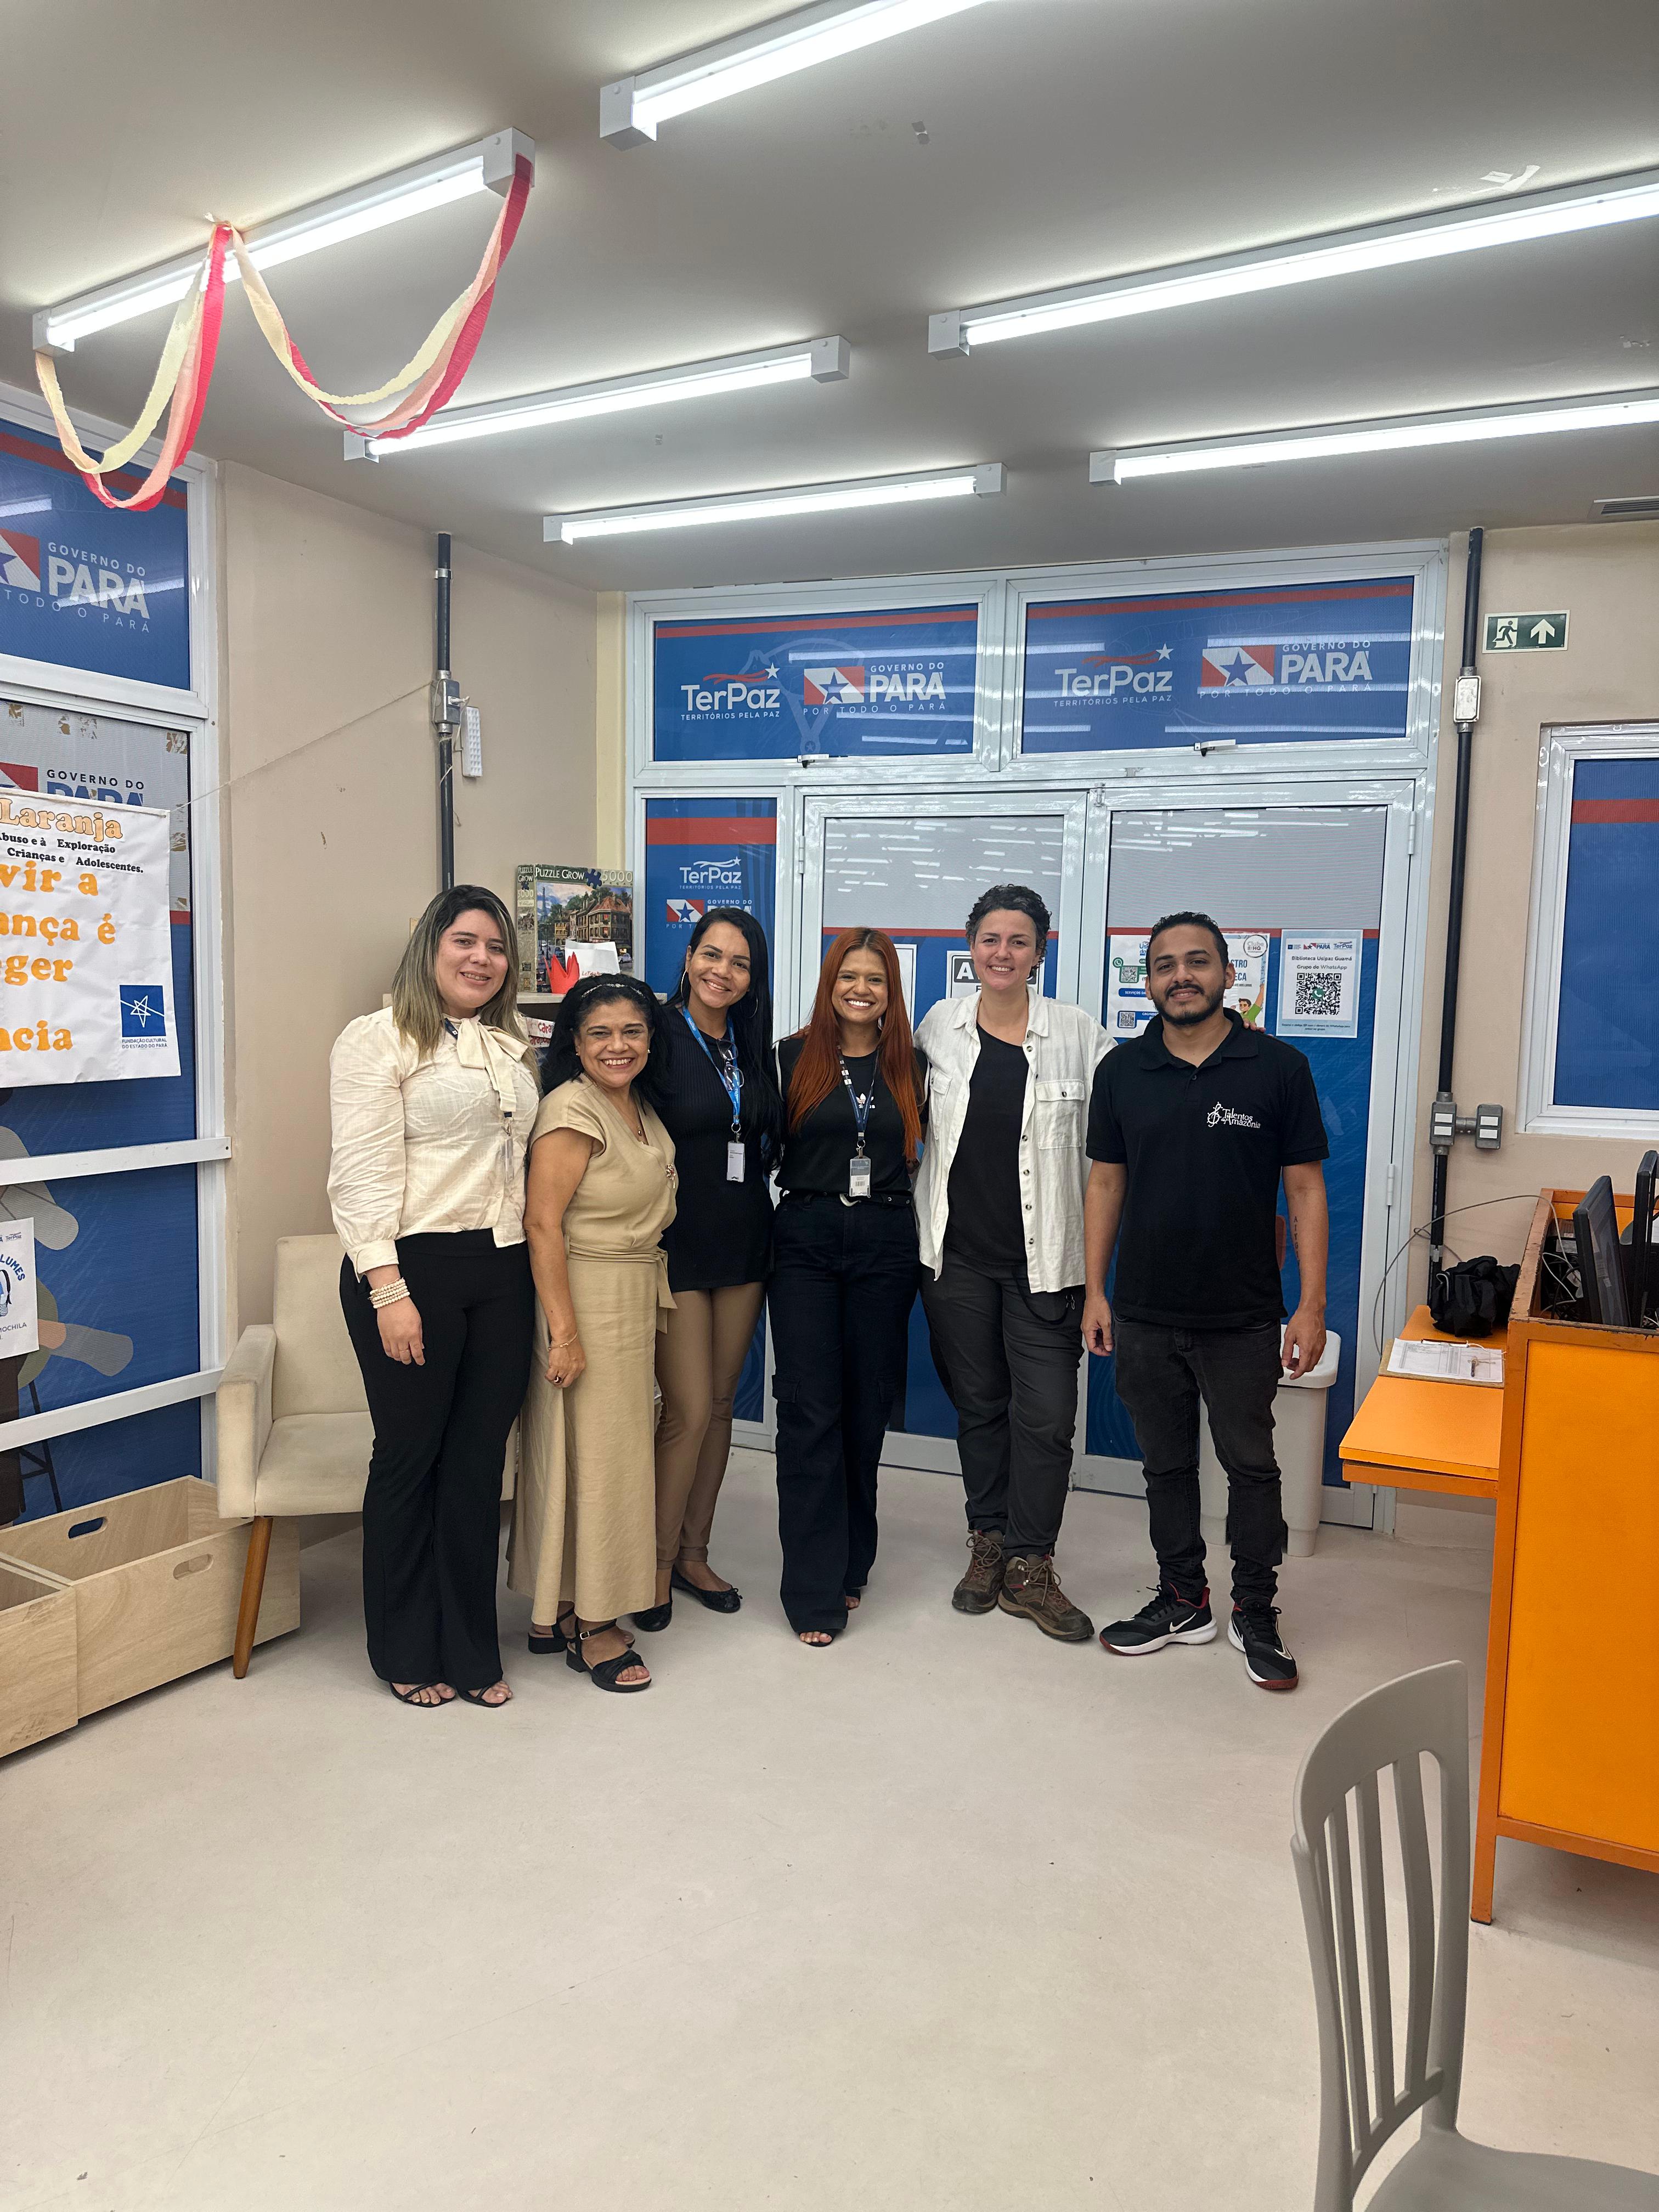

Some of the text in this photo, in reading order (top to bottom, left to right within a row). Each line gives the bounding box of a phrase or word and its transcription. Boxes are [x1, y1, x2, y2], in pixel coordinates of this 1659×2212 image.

[48, 542, 146, 577] GOVERNO DO
[4, 589, 150, 633] TODO O PARÁ
[1283, 642, 1345, 652] GOVERNO
[871, 662, 944, 673] GOVERNO DO
[1055, 665, 1173, 697] TerPaz
[681, 682, 780, 711] TerPaz
[1200, 690, 1231, 699] POR
[1245, 687, 1290, 696] TODO
[1305, 686, 1313, 694] O
[840, 706, 878, 714] TODO
[909, 701, 945, 711] PARÁ
[1054, 698, 1118, 707] TERRITÓRIOS
[681, 712, 735, 720] TERRITÓRIOS
[47, 769, 144, 789] GOVERNO DO
[0, 798, 123, 842] Laranja
[40, 837, 46, 846] à
[57, 838, 115, 854] Exploração
[7, 847, 56, 862] Crianças
[76, 856, 144, 873] Adolescentes.
[535, 867, 633, 883] PUZZLE GROW 5000
[679, 867, 742, 884] TerPaz
[78, 873, 99, 896] a
[518, 890, 534, 898] 5000
[97, 913, 116, 945] é
[1222, 1108, 1253, 1121] Talentos
